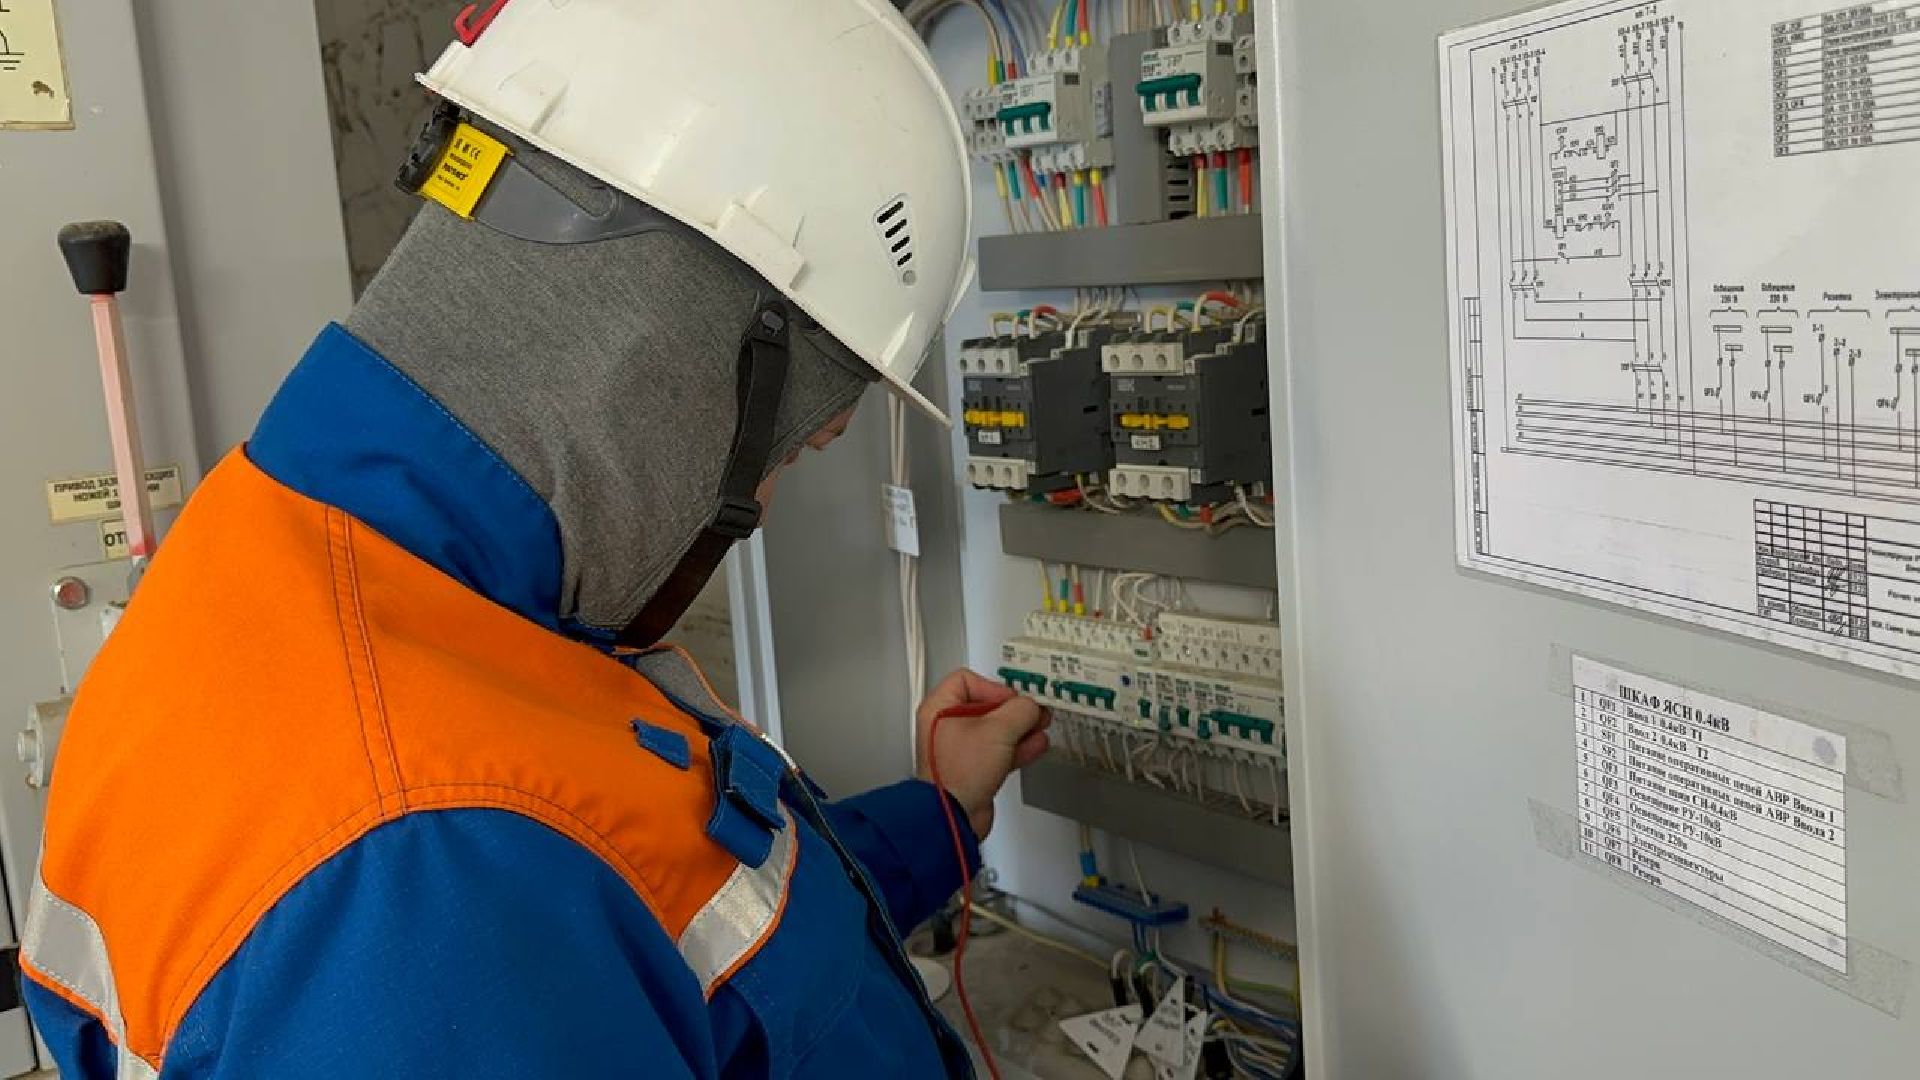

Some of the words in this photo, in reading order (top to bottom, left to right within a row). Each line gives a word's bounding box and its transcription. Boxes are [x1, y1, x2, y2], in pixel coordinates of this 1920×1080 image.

[104, 530, 127, 547] ОТ
[1620, 684, 1660, 709] ШКАФ
[1664, 699, 1693, 721] ЯСН
[1695, 708, 1730, 733] 0.4кВ
[1628, 738, 1666, 760] Питание
[1667, 756, 1730, 786] оперативных
[1765, 788, 1790, 805] АВР
[1793, 797, 1825, 820] Ввода
[1628, 755, 1666, 777] Питание
[1667, 773, 1730, 802] оперативных
[1765, 807, 1790, 823] АВР
[1793, 815, 1825, 838] Ввода
